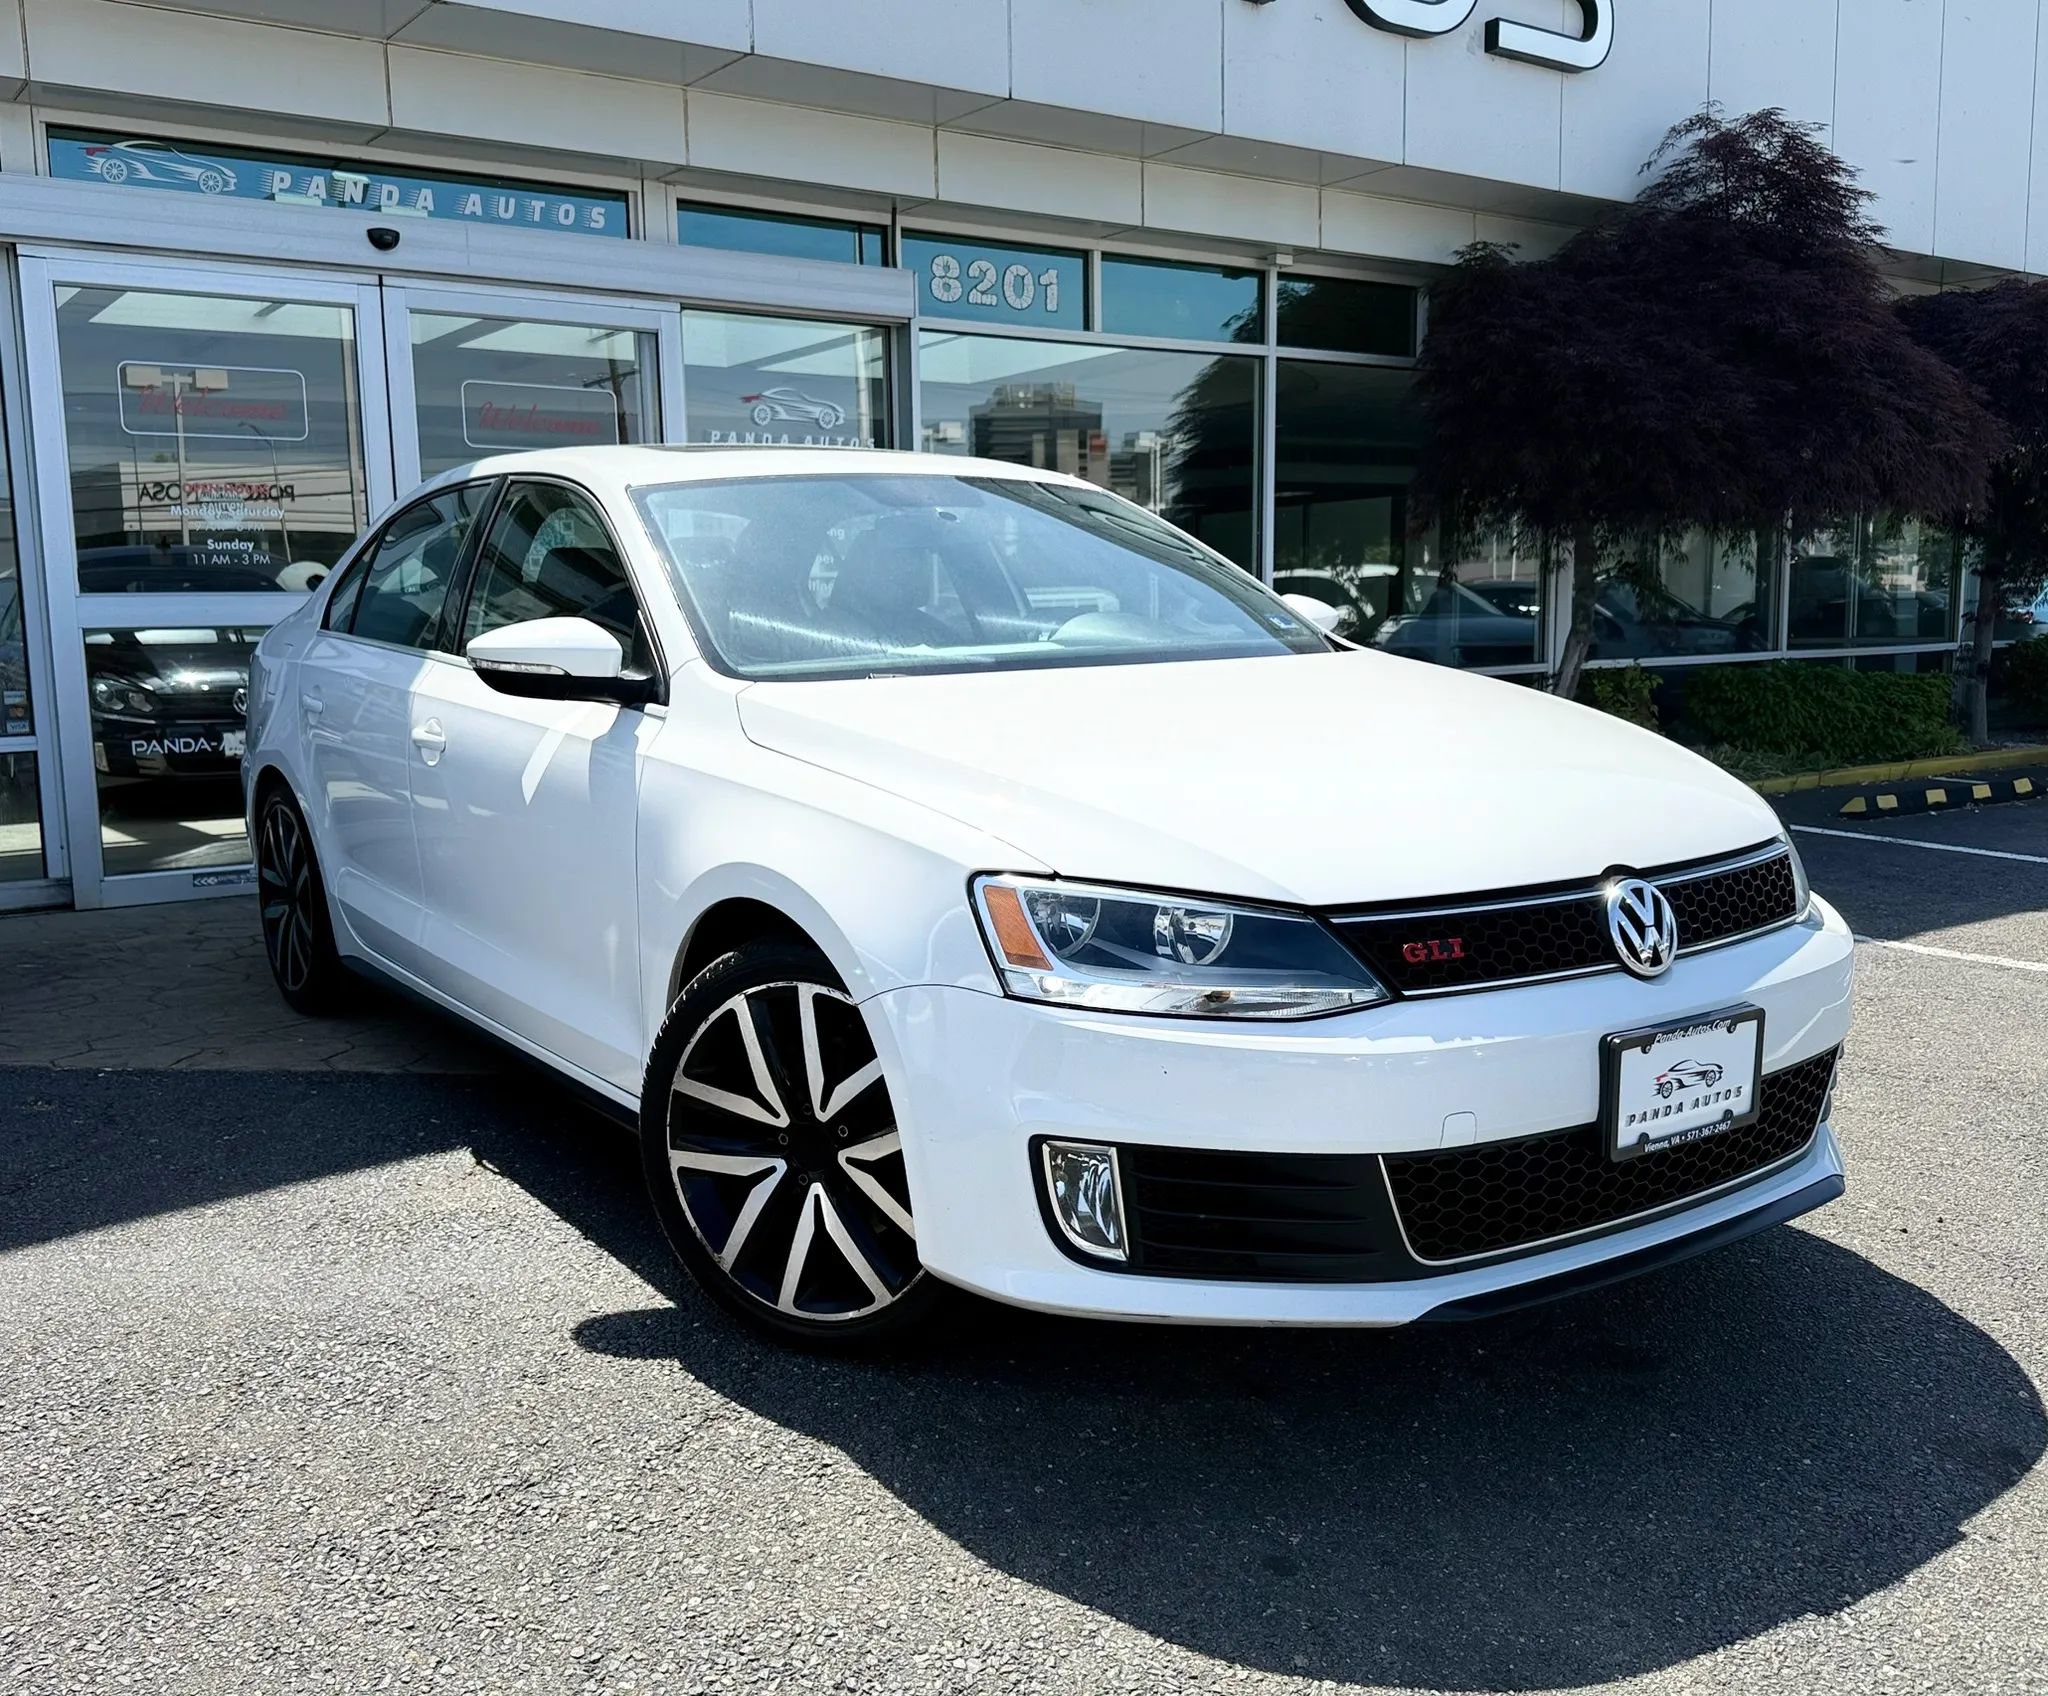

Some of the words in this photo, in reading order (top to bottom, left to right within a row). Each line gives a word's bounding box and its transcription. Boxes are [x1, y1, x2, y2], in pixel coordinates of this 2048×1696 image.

[258, 169, 435, 211] PANDA
[456, 194, 606, 229] AUTOS
[931, 255, 1058, 312] 8201
[710, 430, 790, 445] PANDA
[804, 435, 876, 449] AUTOS
[207, 538, 254, 552] Sunday
[193, 554, 206, 565] 11
[211, 554, 231, 565] AM
[242, 554, 250, 565] 3
[253, 554, 271, 565] PM
[1402, 938, 1464, 963] GLI
[1654, 1019, 1731, 1044] Panda-Autos.Com
[1626, 1102, 1684, 1126] PANDA
[1691, 1086, 1742, 1110] AUTOS
[1644, 1139, 1670, 1152] Vienna,
[1671, 1137, 1680, 1146] VA
[1687, 1121, 1731, 1141] 571-367-2467
